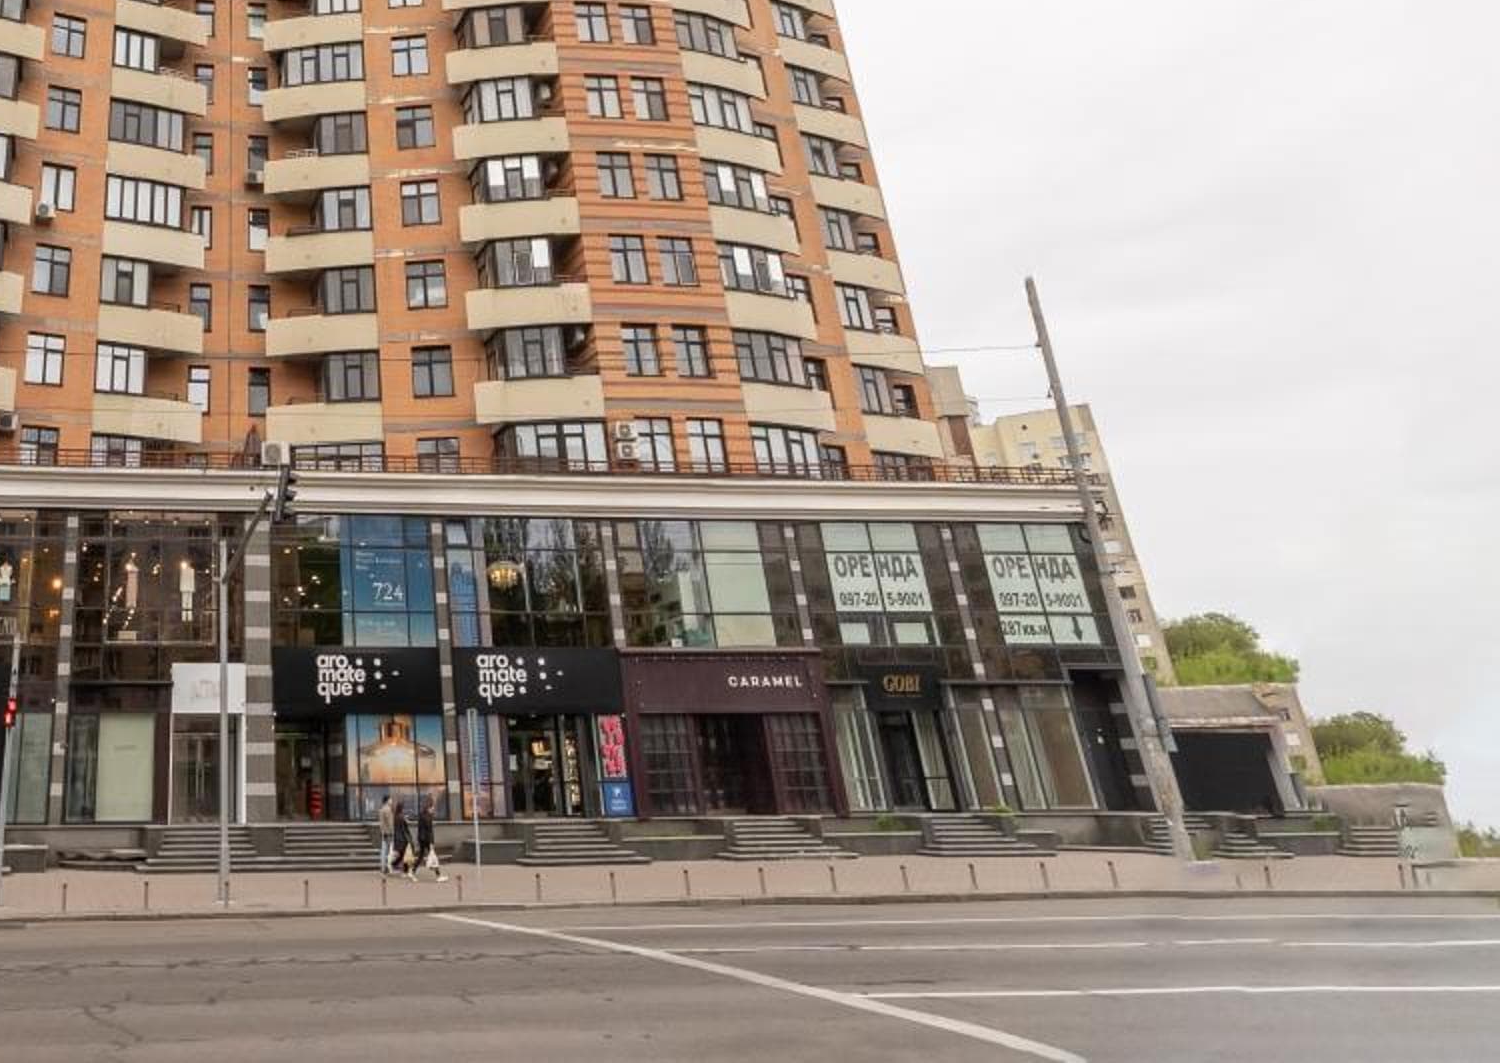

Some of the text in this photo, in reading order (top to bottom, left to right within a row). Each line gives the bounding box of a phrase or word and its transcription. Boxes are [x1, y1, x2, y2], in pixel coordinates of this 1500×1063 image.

[834, 555, 919, 582] ОРЕНДА
[992, 556, 1077, 584] ОРЕНДА
[372, 582, 404, 601] 724
[316, 654, 349, 668] aro
[476, 654, 509, 668] aro
[318, 664, 367, 682] mate
[479, 665, 527, 683] mate
[727, 675, 803, 688] CARAMEL
[883, 674, 920, 692] GOBI
[317, 682, 353, 704] que
[479, 683, 515, 705] que
